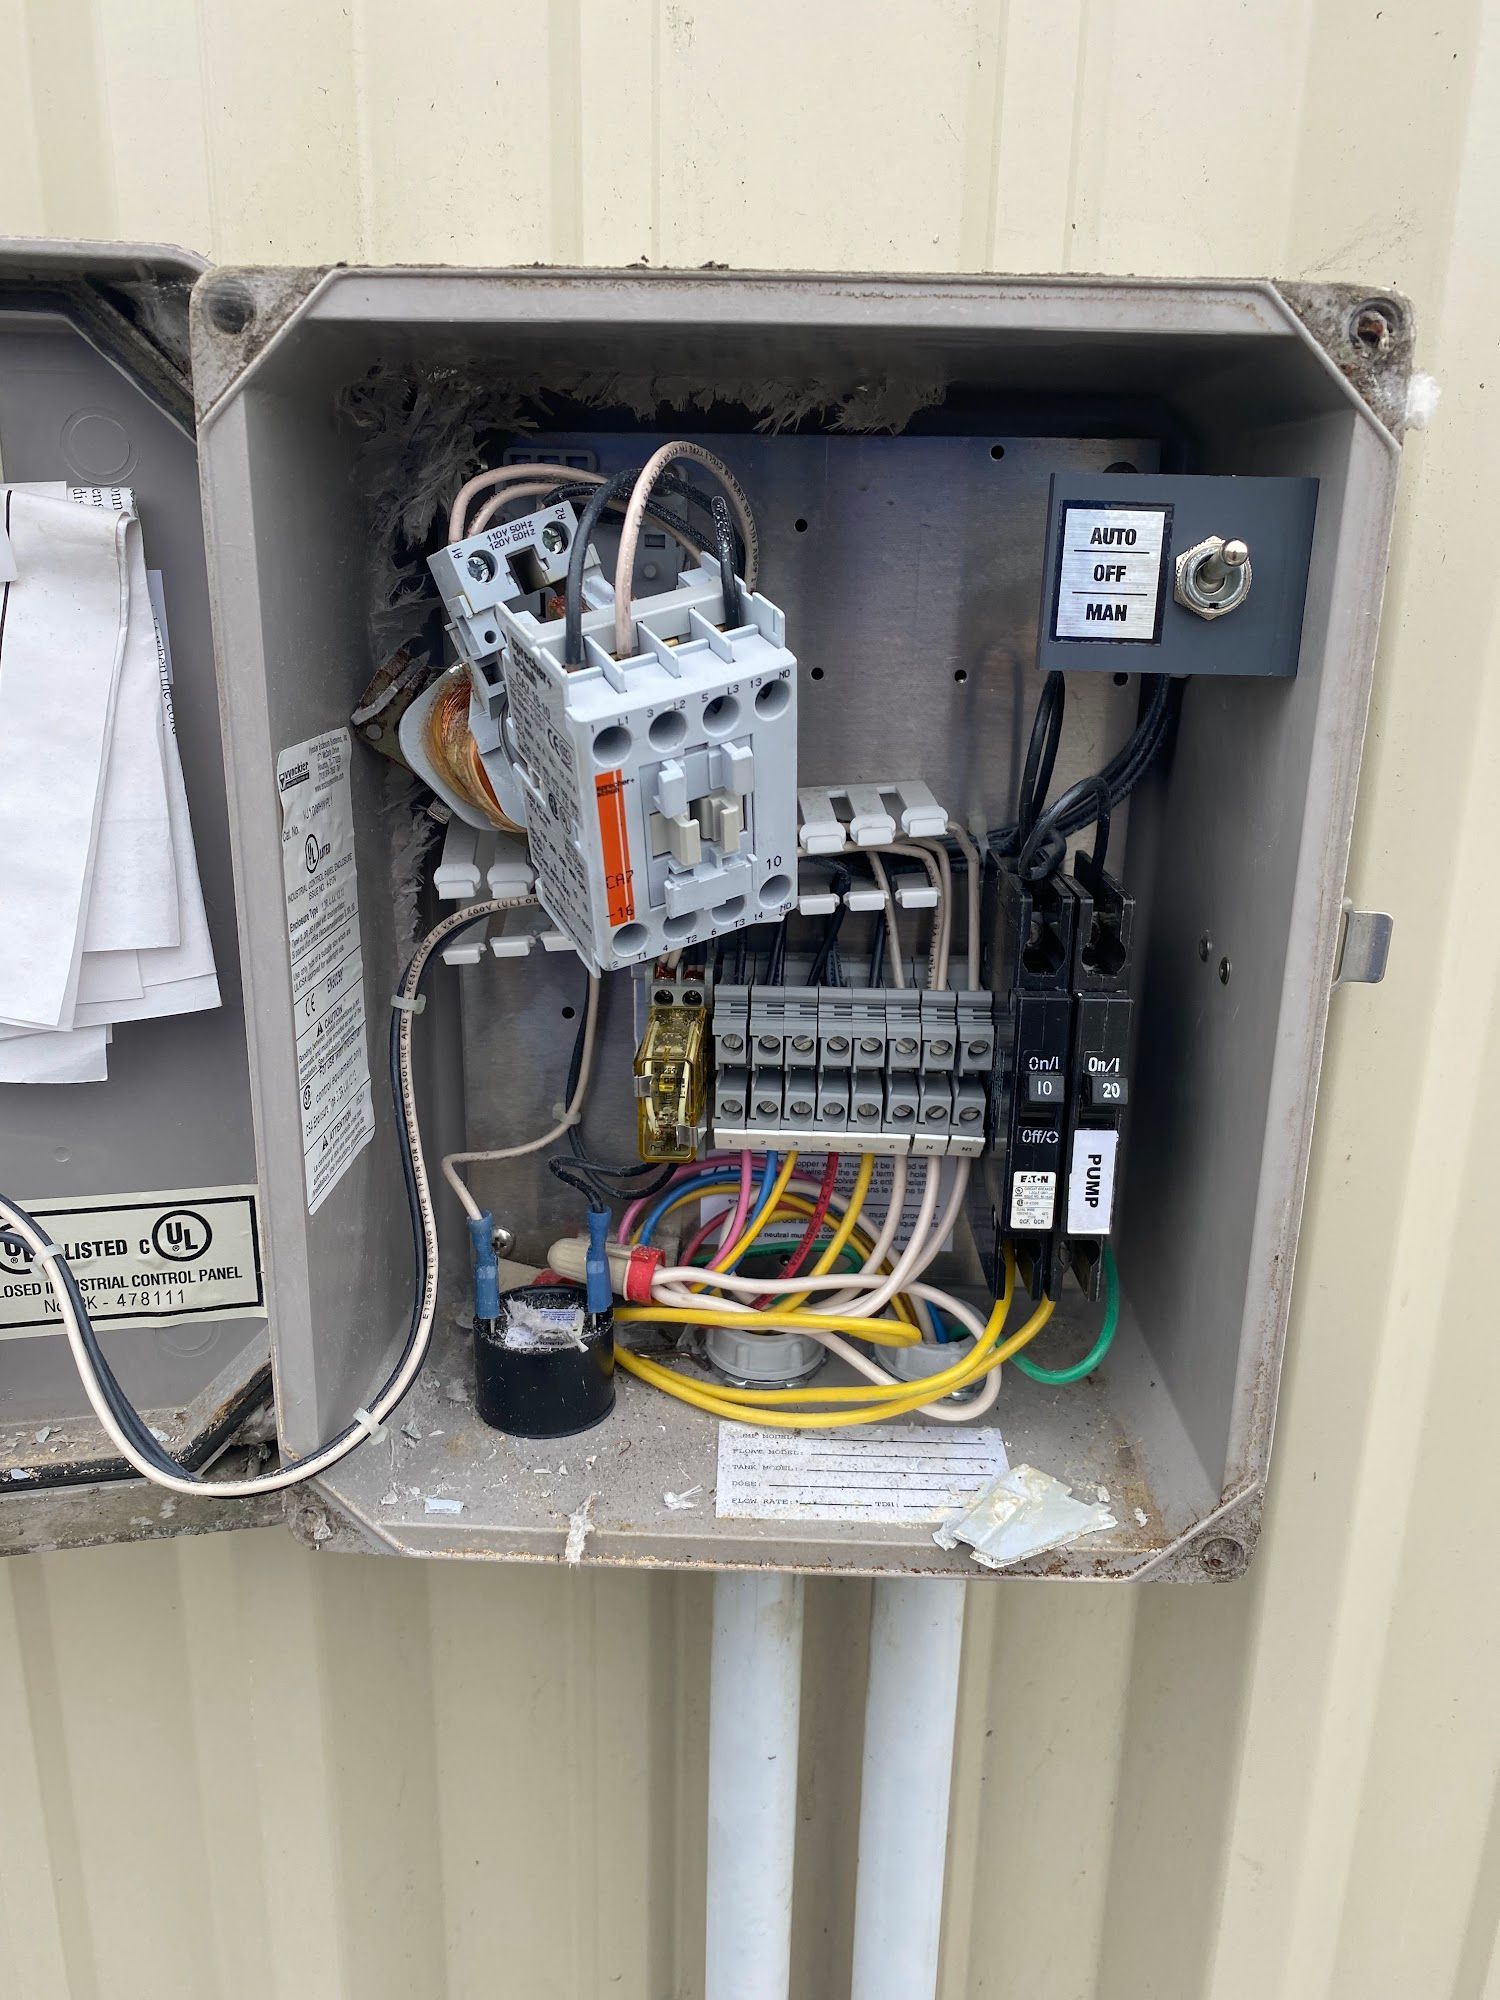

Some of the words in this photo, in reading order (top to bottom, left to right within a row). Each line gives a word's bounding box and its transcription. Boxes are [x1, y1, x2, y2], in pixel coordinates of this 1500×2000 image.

[556, 507, 566, 520] A2
[486, 529, 508, 542] 110V
[489, 538, 511, 550] 120V
[512, 528, 536, 542] 60Hz
[1090, 527, 1137, 546] AUTO
[453, 547, 464, 560] A1
[1093, 564, 1126, 582] OFF
[1085, 604, 1128, 622] MAN
[646, 708, 654, 718] 3
[674, 700, 686, 710] L2
[702, 692, 708, 703] 5
[726, 684, 740, 696] L3
[750, 678, 762, 688] 13
[766, 856, 782, 870] 10
[400, 1044, 410, 1098] GASOLINE
[1037, 1080, 1053, 1096] 10
[1102, 1082, 1120, 1099] 20
[412, 1148, 420, 1162] OR
[1084, 1154, 1102, 1208] PUMP
[420, 1198, 431, 1225] TYPE
[64, 1238, 128, 1261] LISTED
[139, 1239, 150, 1254] C
[166, 1222, 198, 1250] UL
[764, 1230, 789, 1239] neutral
[0, 1282, 42, 1298] OSED
[132, 1271, 196, 1290] CONTROL
[199, 1266, 242, 1282] PANEL
[116, 1289, 185, 1307] 478111
